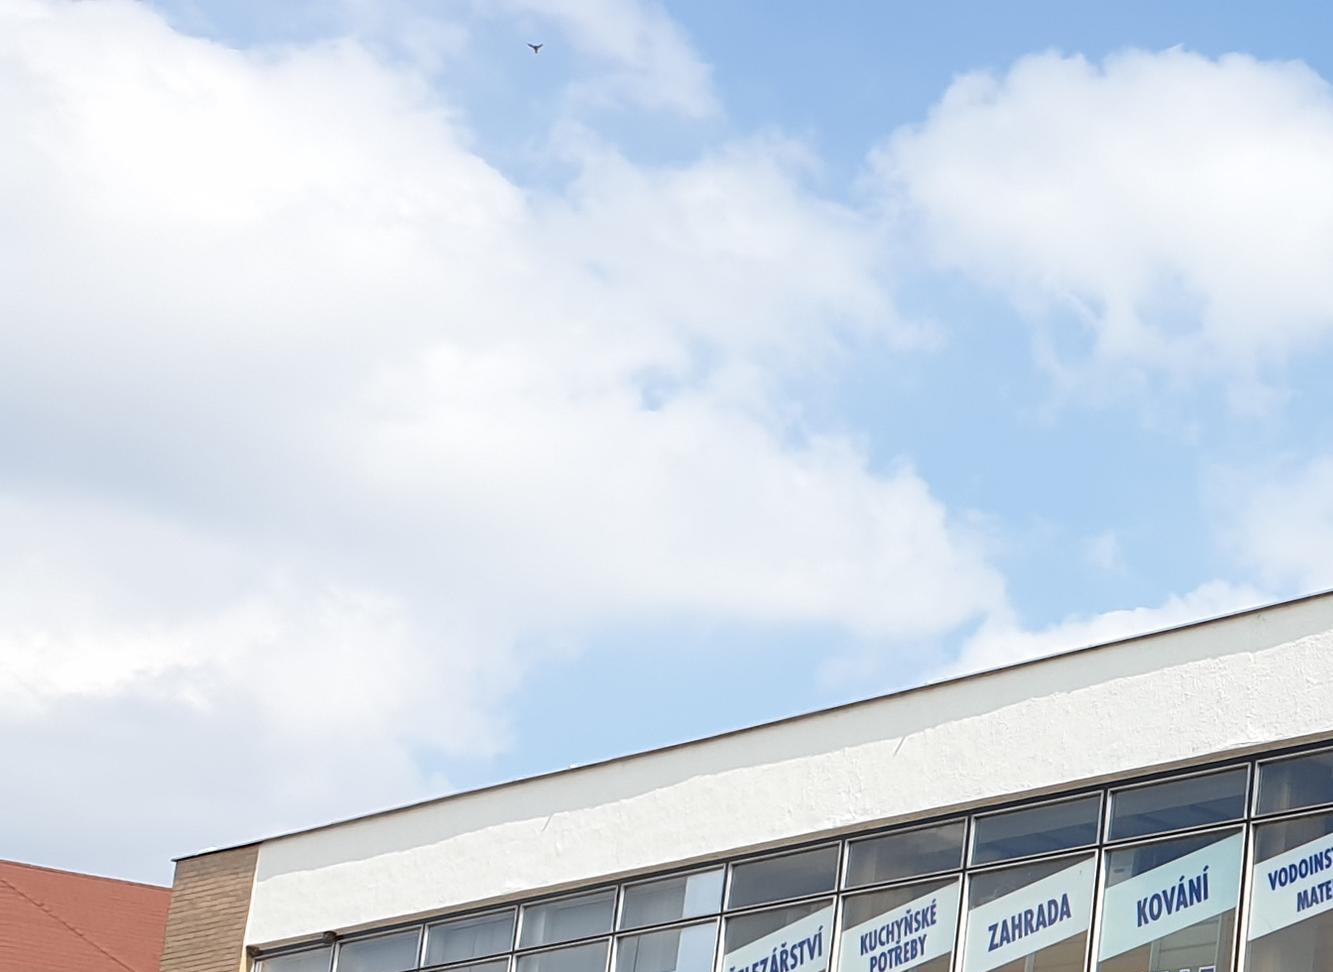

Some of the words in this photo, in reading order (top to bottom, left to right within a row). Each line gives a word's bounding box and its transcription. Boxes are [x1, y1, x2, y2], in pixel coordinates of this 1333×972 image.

[988, 893, 1072, 952] ZAHRADA
[1136, 865, 1210, 928] KOVÁNÍ
[860, 898, 938, 957] KUCHYŇSKÉ
